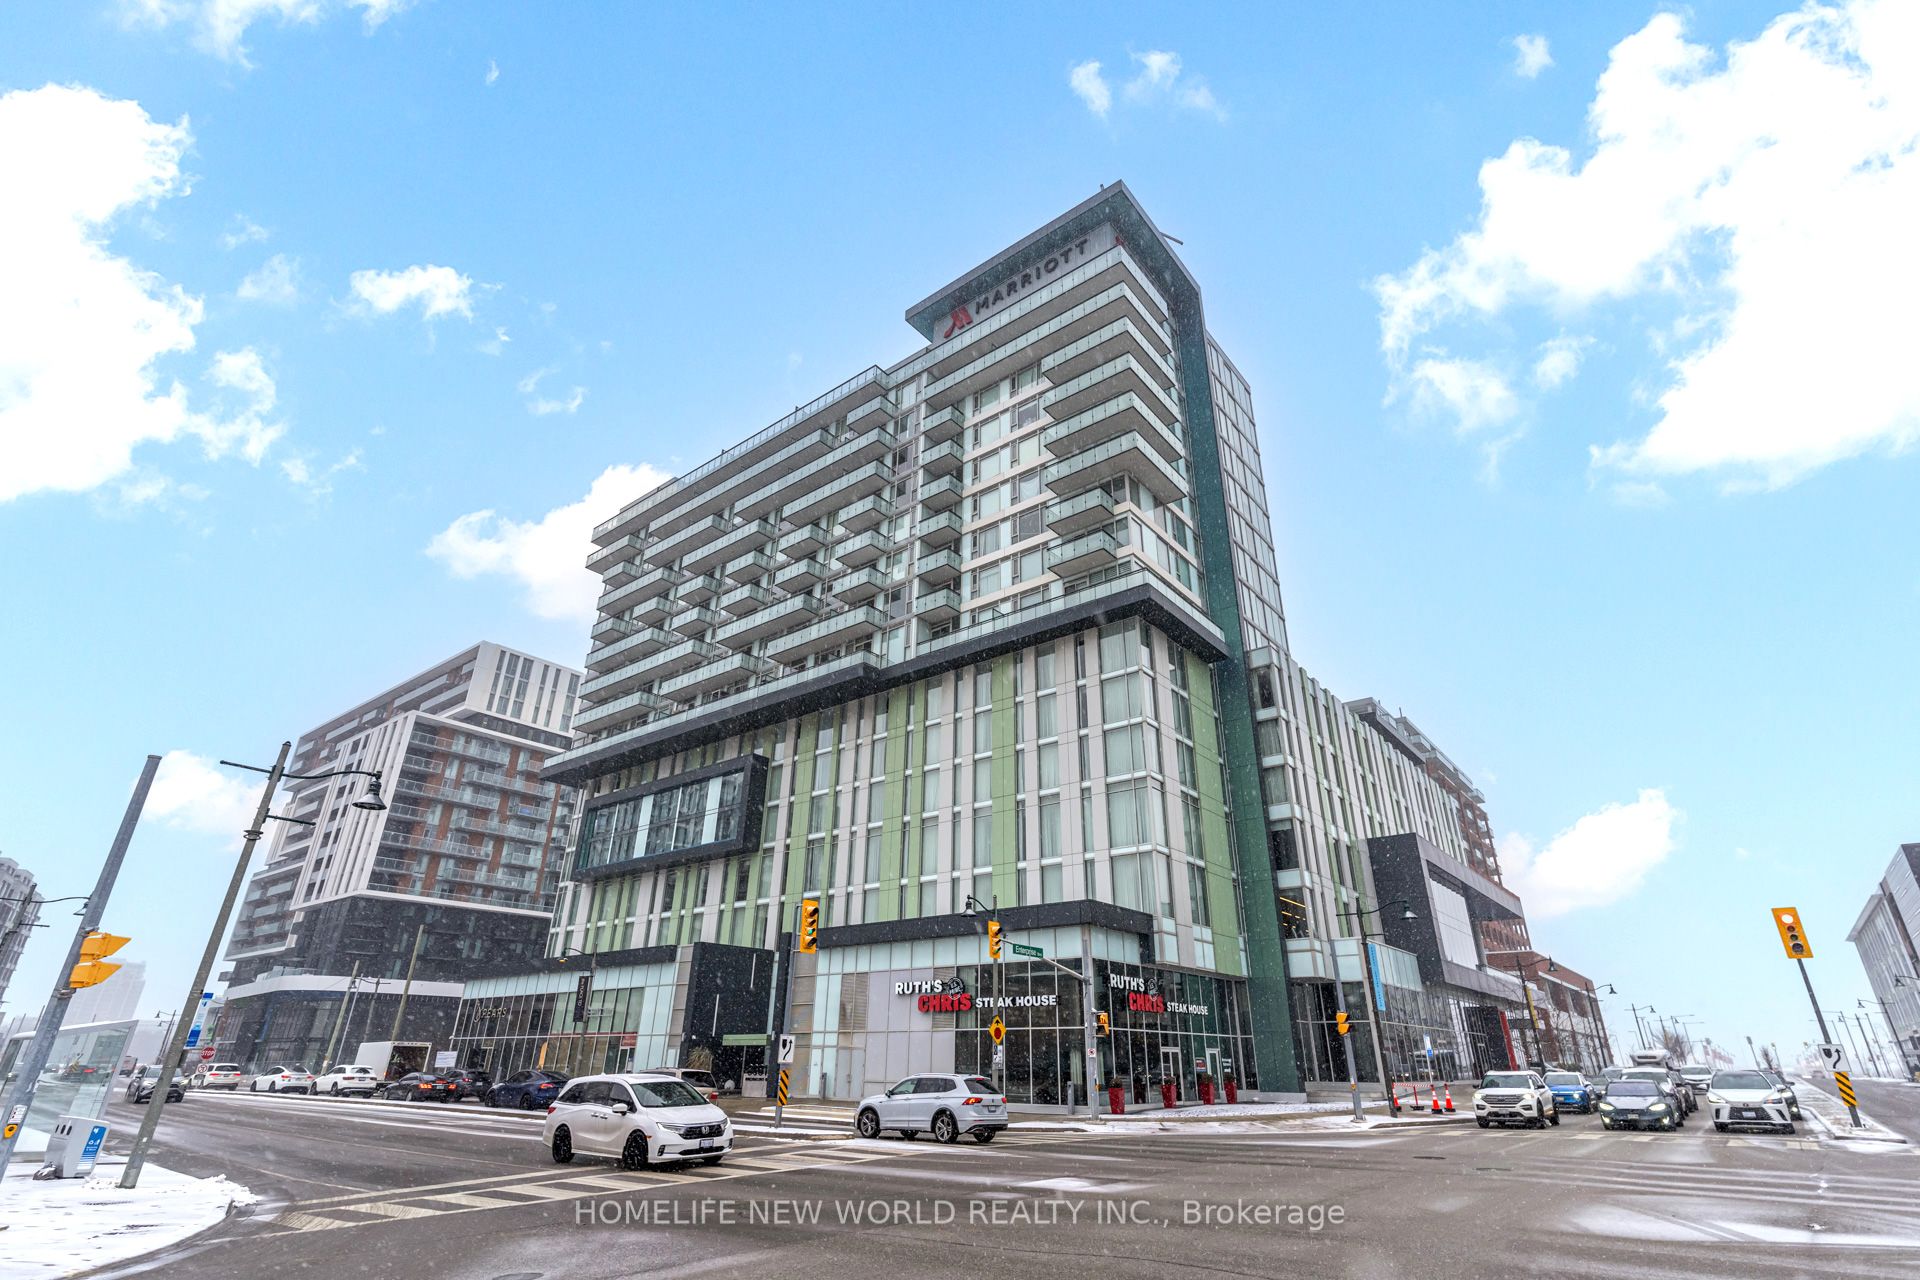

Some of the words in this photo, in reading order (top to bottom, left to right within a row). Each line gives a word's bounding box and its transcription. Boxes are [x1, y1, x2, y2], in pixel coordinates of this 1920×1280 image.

[975, 238, 1089, 315] MARRIOTT
[1015, 946, 1037, 956] Enterprise
[895, 980, 943, 995] RUTH'S
[1109, 973, 1145, 992] RUTH'S
[917, 993, 972, 1013] CHRIS
[975, 996, 1014, 1008] STEAK
[1016, 994, 1058, 1008] HOUSE
[1128, 991, 1165, 1014] CHRIS
[1166, 1001, 1188, 1013] STEAK
[1188, 1003, 1209, 1015] HOUSE
[481, 1007, 508, 1019] PEARS
